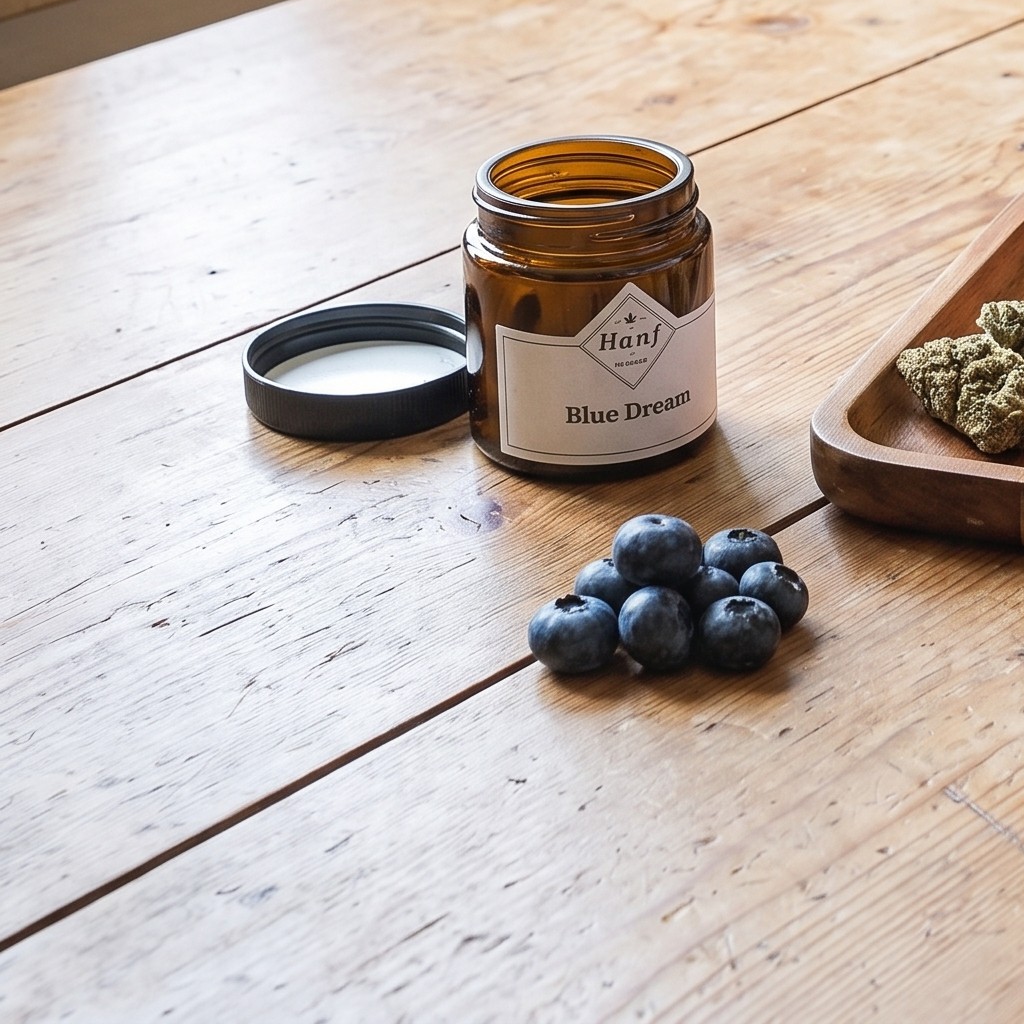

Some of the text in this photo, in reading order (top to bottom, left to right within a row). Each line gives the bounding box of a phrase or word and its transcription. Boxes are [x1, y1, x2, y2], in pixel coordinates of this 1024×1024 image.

[598, 323, 662, 352] Hanf
[565, 389, 691, 424] Blue Dream
